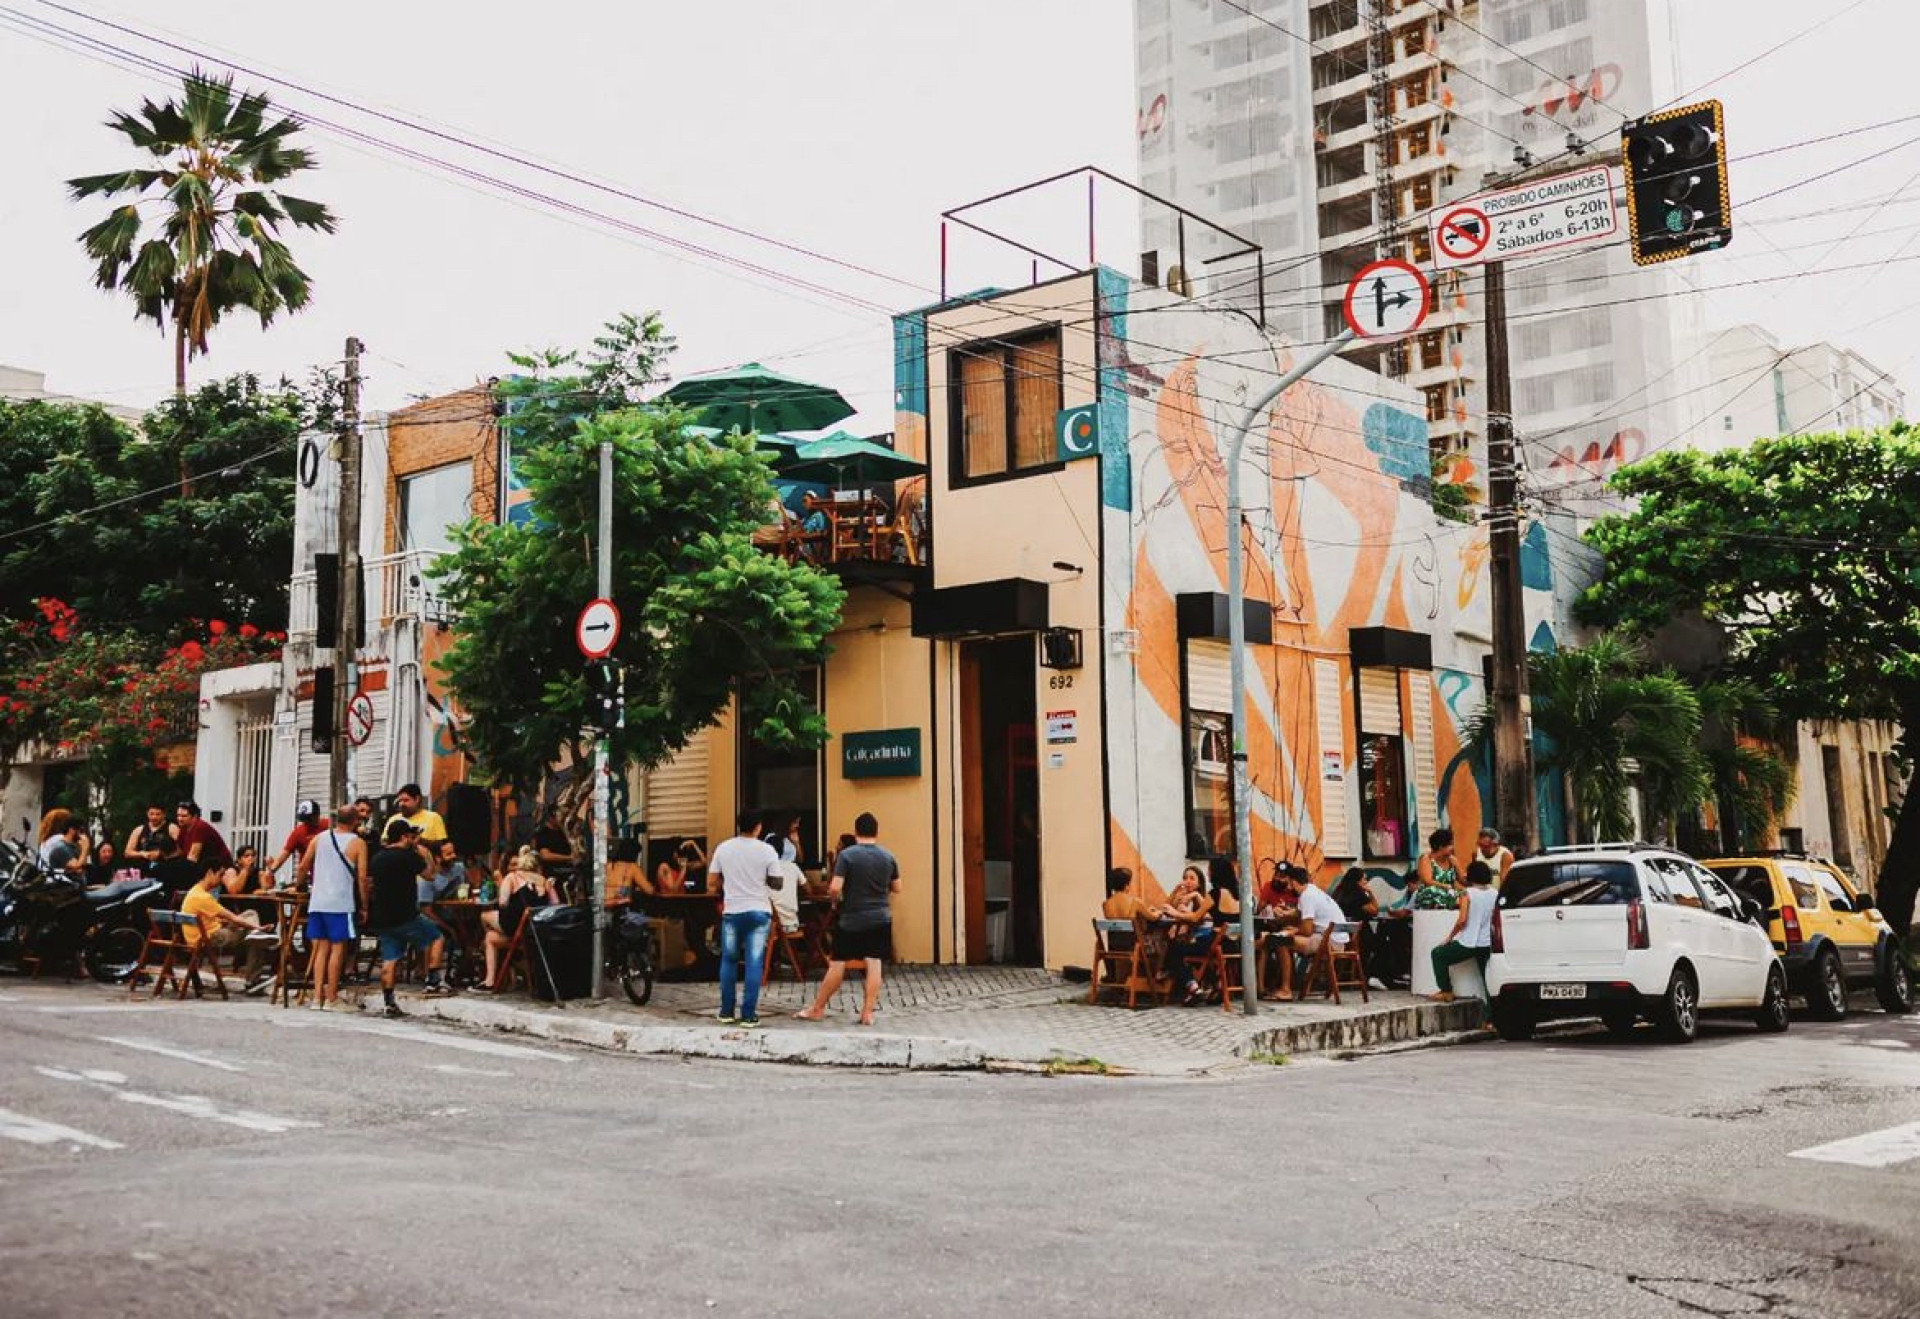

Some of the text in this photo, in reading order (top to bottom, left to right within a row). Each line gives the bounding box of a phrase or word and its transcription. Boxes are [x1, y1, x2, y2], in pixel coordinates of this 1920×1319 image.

[1483, 189, 1537, 213] PROIBIDO
[1517, 219, 1526, 231] a
[1565, 198, 1608, 219] 6-20h
[1496, 215, 1611, 252] Sábados 6-13h
[1064, 411, 1094, 452] C
[1049, 675, 1074, 690] 692
